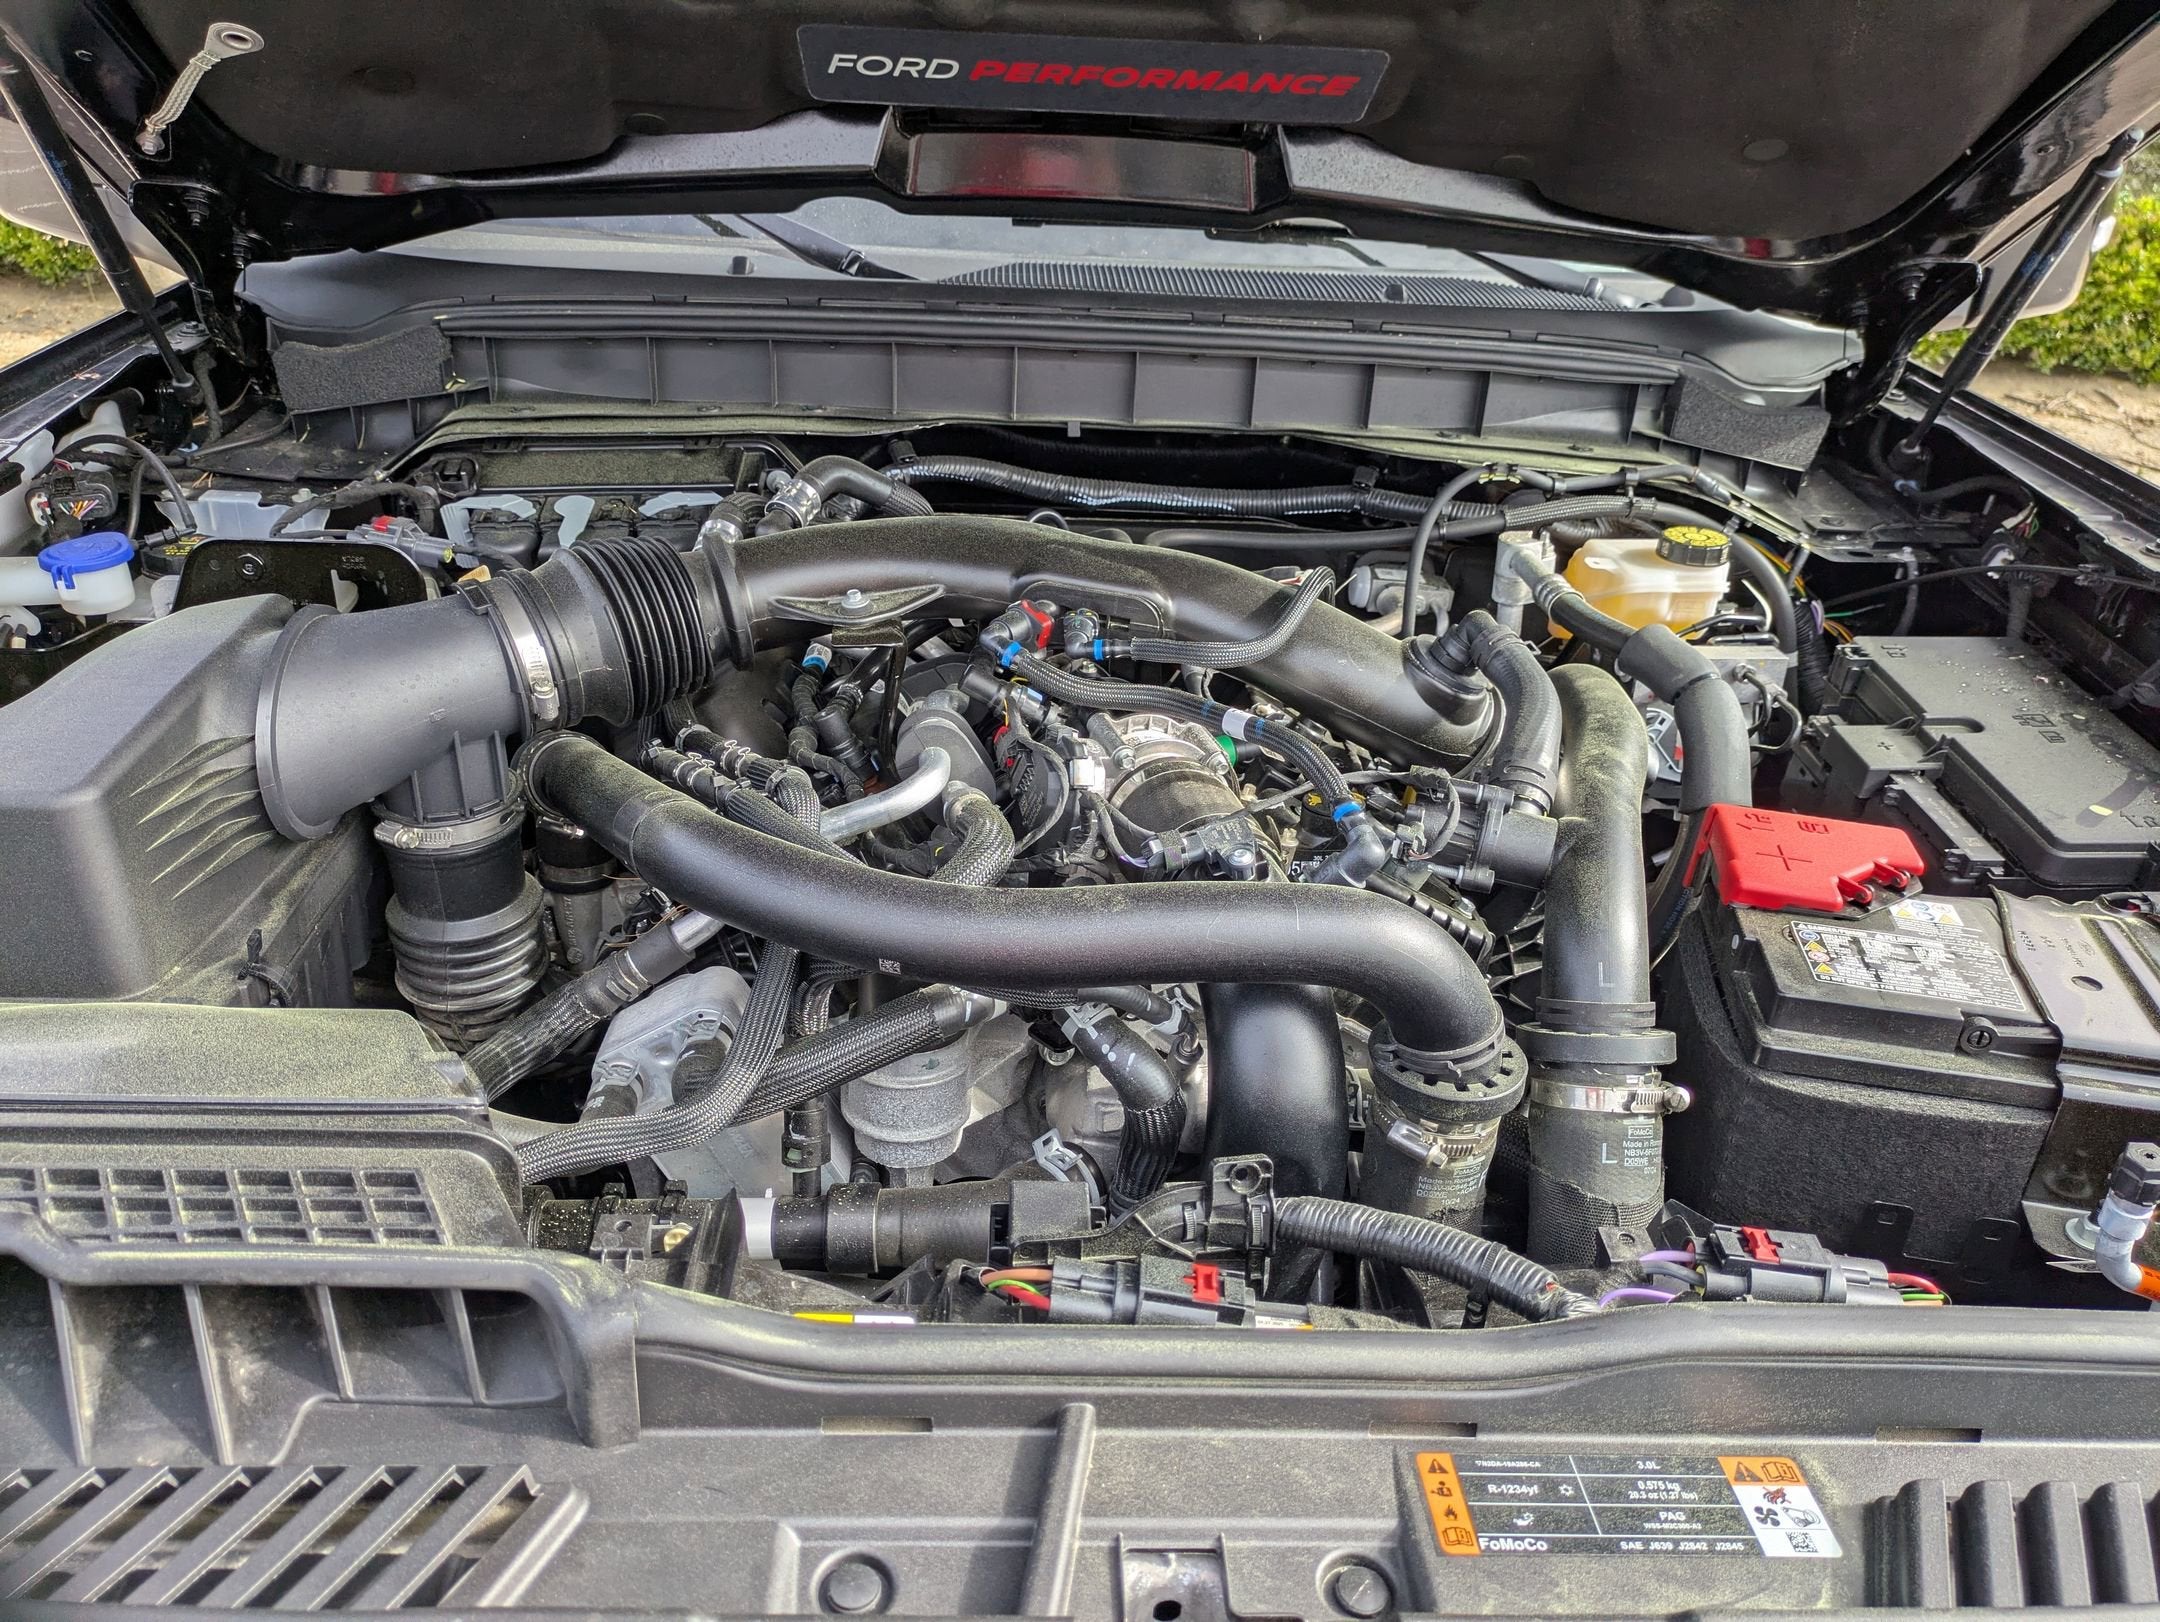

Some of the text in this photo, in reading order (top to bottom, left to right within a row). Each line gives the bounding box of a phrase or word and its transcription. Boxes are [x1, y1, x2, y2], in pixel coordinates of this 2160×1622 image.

[827, 53, 1361, 97] FORD PERFORMANCE
[1598, 961, 1616, 987] L
[1622, 1140, 1643, 1148] Made
[1602, 1143, 1617, 1163] L
[1418, 1175, 1443, 1185] Made
[1636, 1461, 1660, 1470] 3.0L
[1488, 1480, 1680, 1496] R-1234yf 0.575 kg
[1628, 1491, 1646, 1499] 20.3
[1659, 1491, 1680, 1500] (1.27
[1680, 1491, 1698, 1501] lbs)
[1659, 1511, 1686, 1521] PAG
[1478, 1537, 1745, 1551] FoMoCo SAE J639 J2842 J2845
